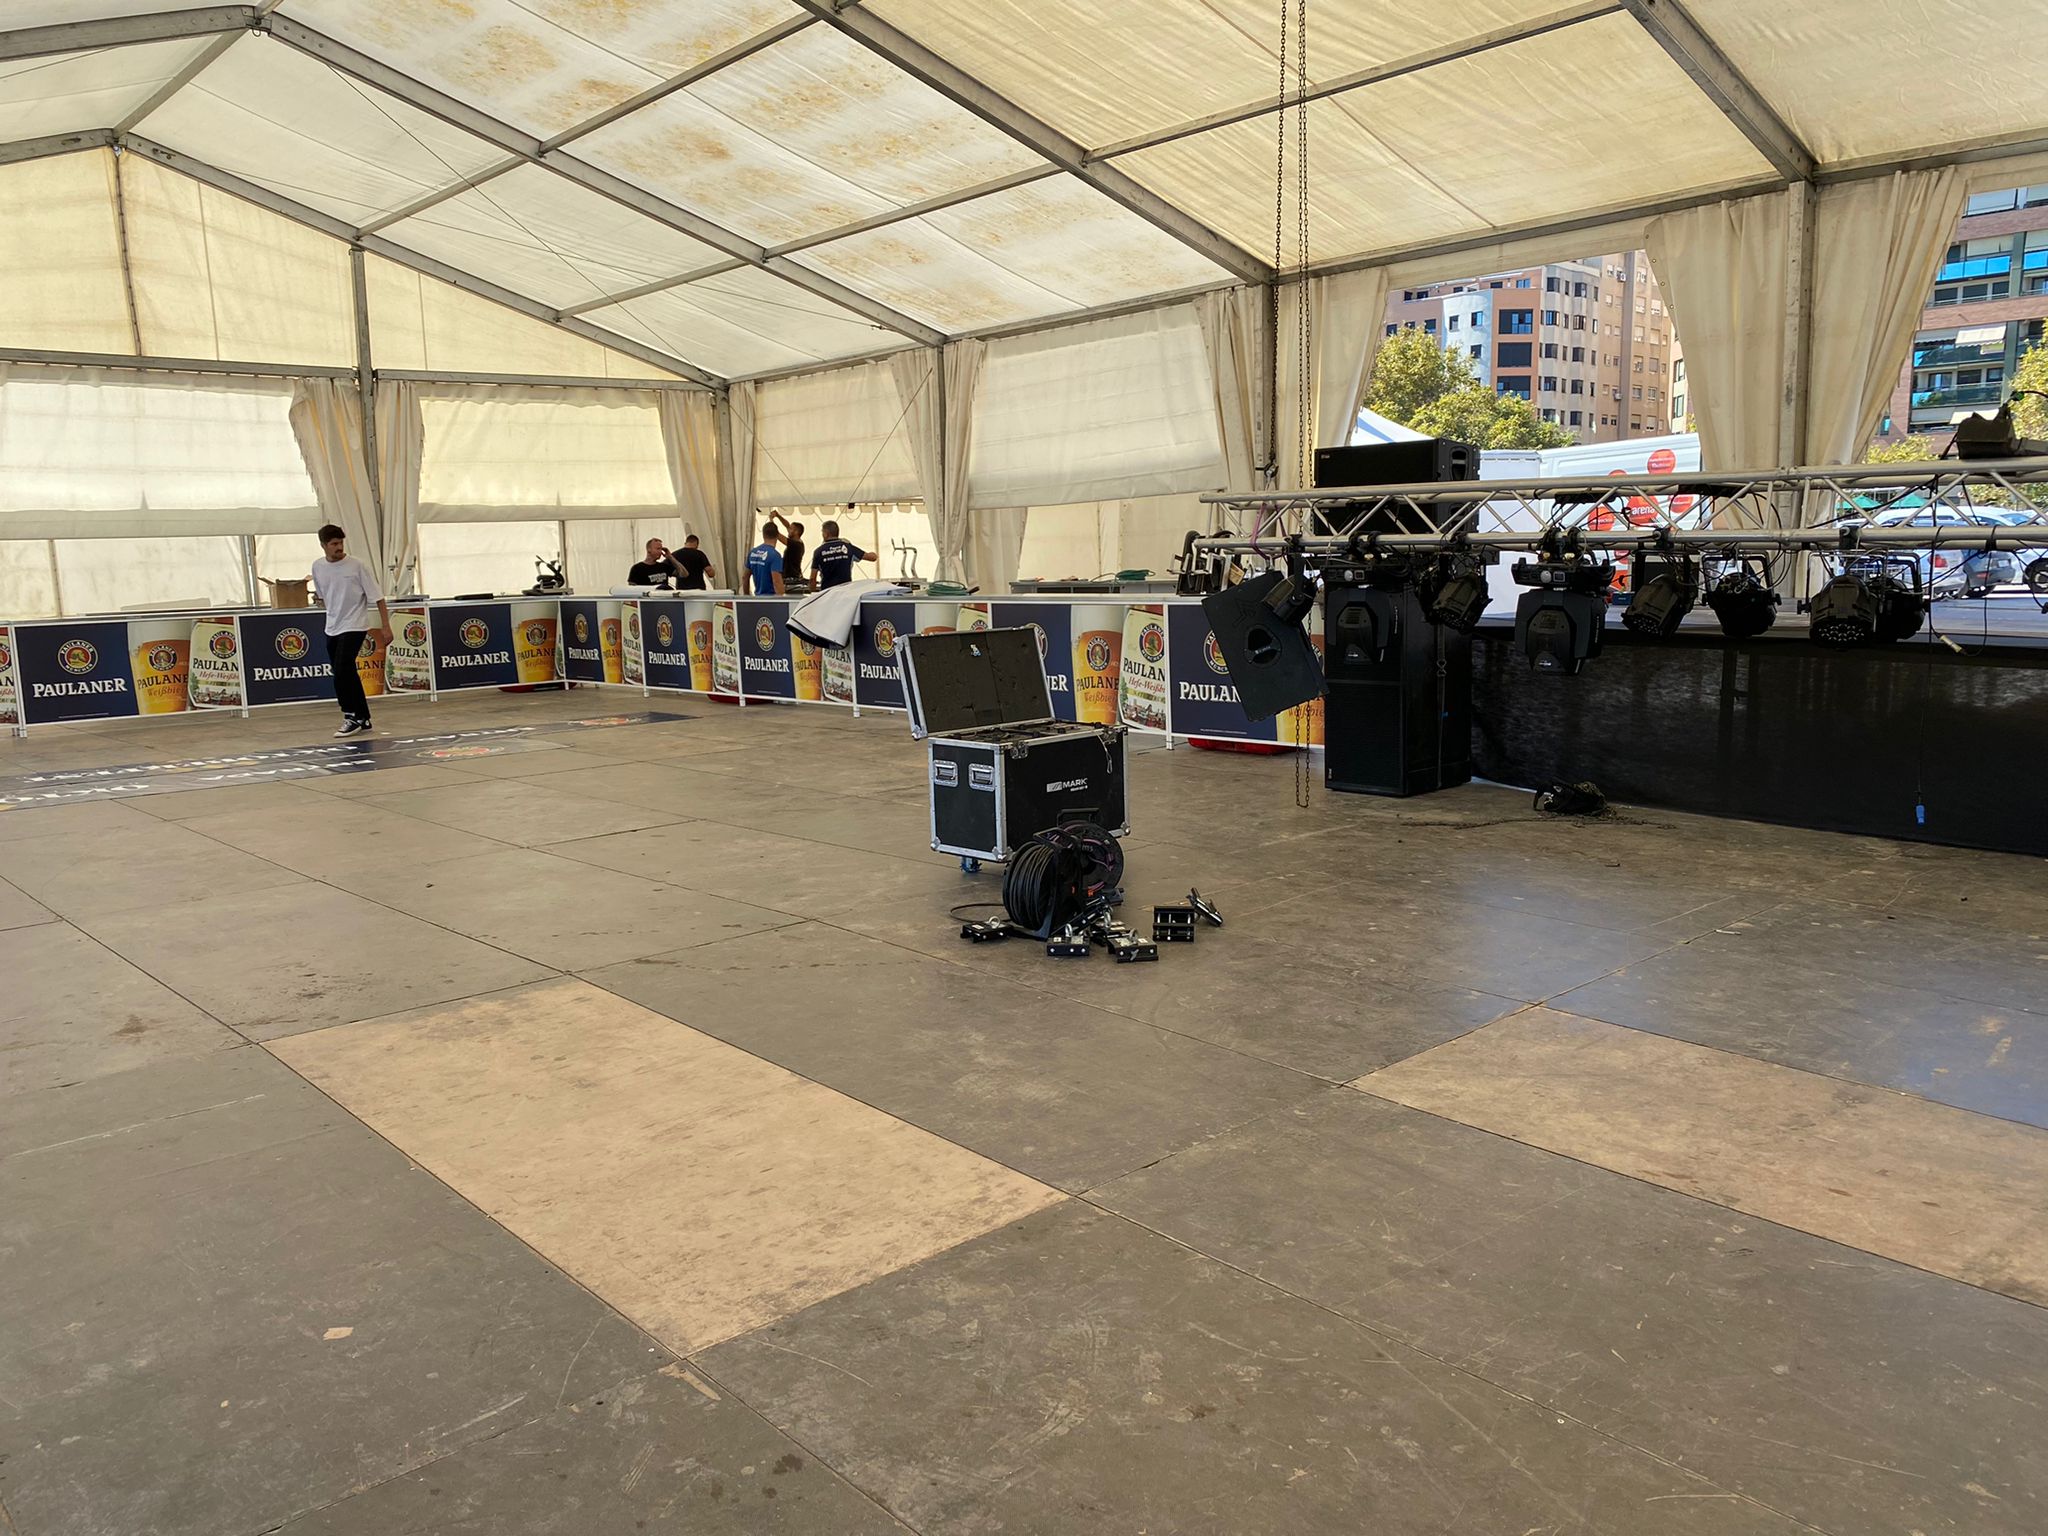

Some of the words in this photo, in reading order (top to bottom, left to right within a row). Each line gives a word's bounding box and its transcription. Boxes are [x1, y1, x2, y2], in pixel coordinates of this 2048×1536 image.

[1632, 506, 1656, 516] arena
[389, 645, 428, 658] PAULAN
[568, 647, 600, 661] PAULANER
[648, 651, 687, 666] PAULANER
[193, 658, 239, 671] PAULAN
[441, 651, 511, 668] PAULANER
[744, 656, 790, 673] PAULANER
[253, 663, 334, 681] PAULANER
[1123, 658, 1165, 682] PAULAN
[32, 678, 127, 698] PAULANER
[1063, 778, 1088, 788] MARK
